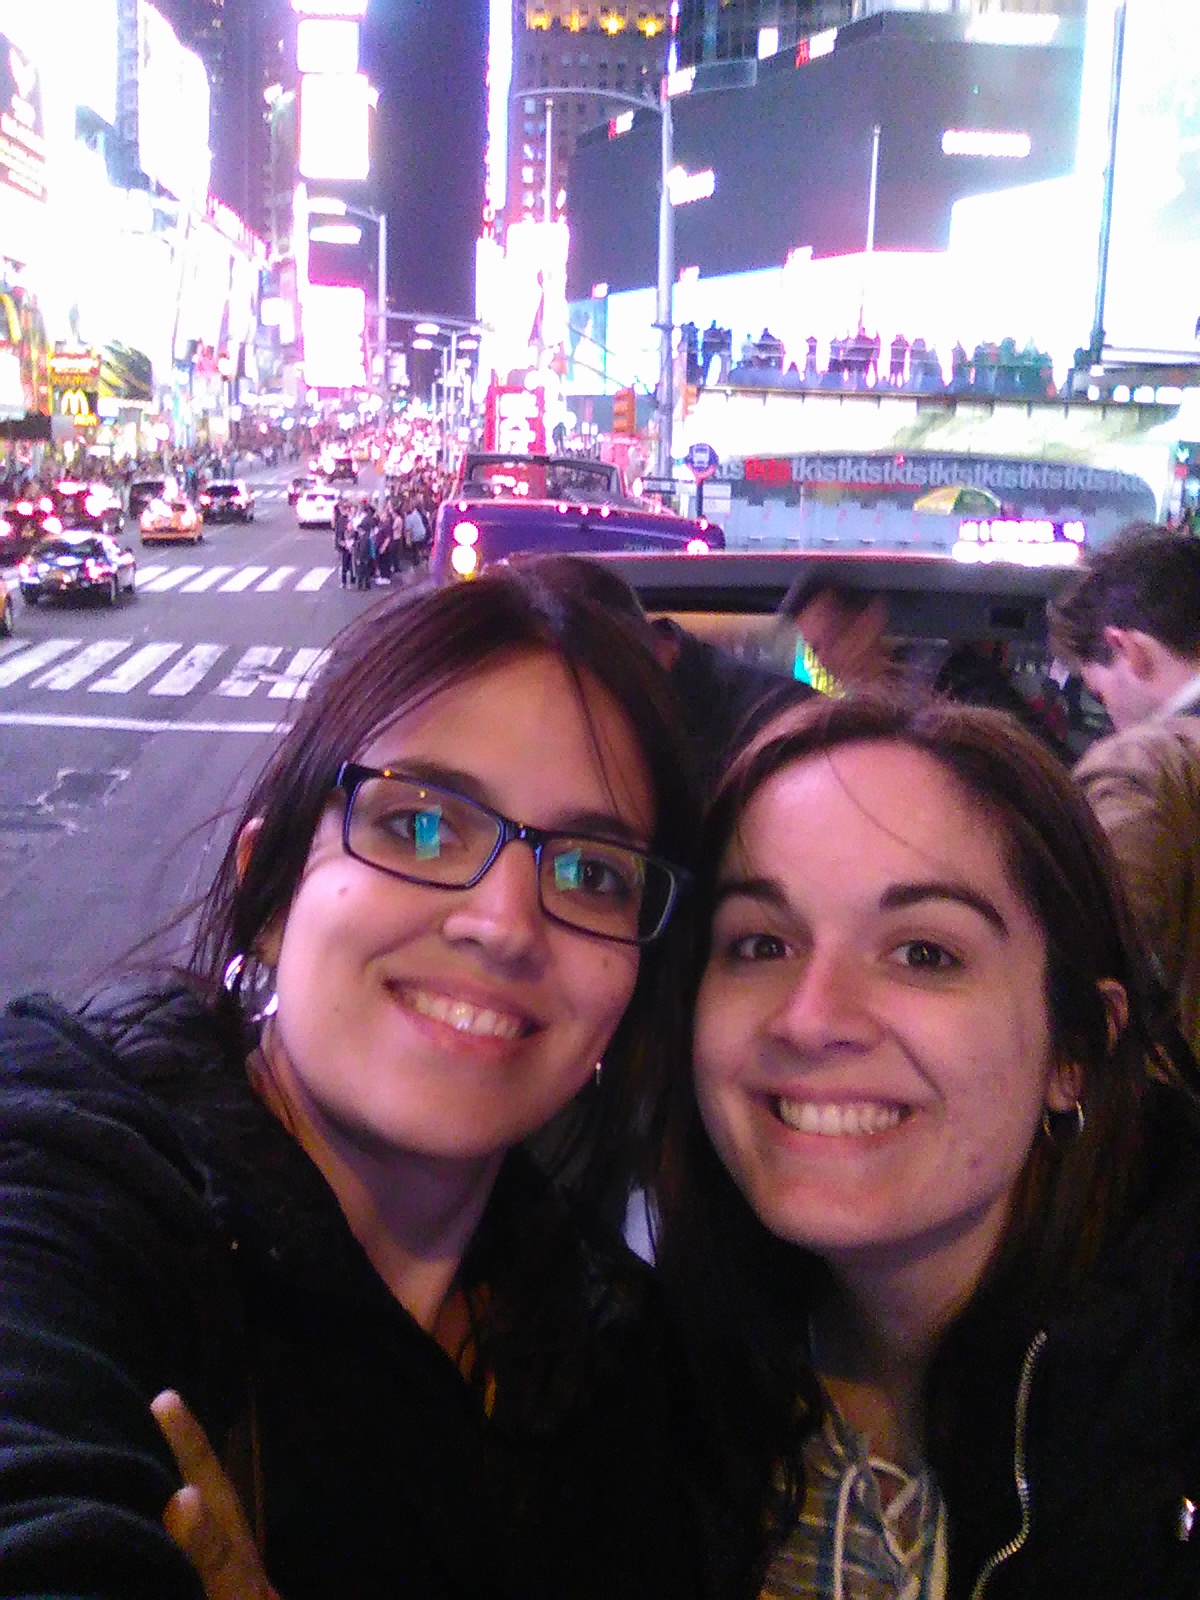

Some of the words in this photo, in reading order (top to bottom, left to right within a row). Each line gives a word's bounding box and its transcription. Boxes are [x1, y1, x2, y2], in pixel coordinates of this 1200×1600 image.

[744, 456, 790, 482] tkts
[791, 458, 838, 482] tkts
[838, 459, 883, 483] tkts
[883, 460, 928, 484] tkts
[929, 461, 974, 486] tkts
[974, 462, 1019, 488] tkts
[1020, 464, 1063, 489] tkts
